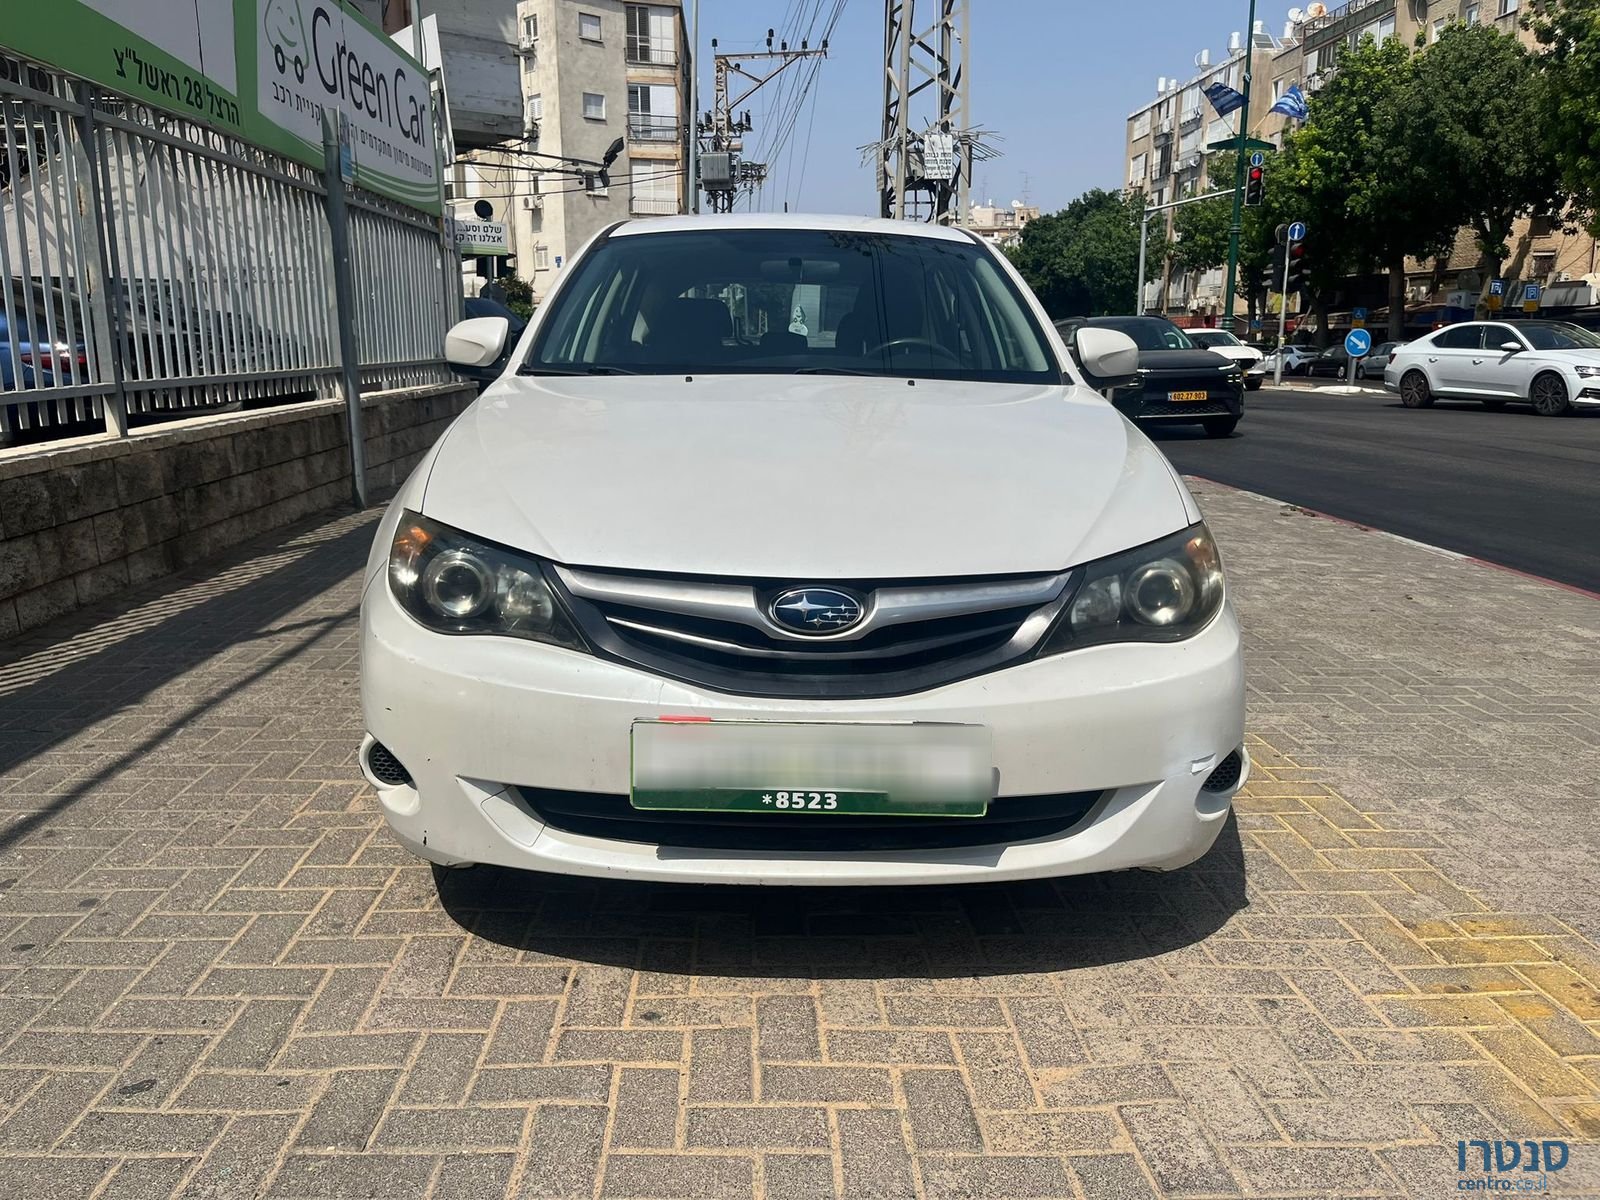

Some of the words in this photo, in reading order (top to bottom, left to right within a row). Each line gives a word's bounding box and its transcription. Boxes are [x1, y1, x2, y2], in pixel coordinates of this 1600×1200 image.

[312, 7, 392, 128] Green
[394, 68, 426, 148] Car
[184, 76, 203, 110] 28
[205, 84, 240, 126] הרצל
[272, 81, 293, 108] רכב
[467, 234, 477, 242] זה
[479, 233, 503, 243] אצלנו
[482, 224, 502, 234] שלם
